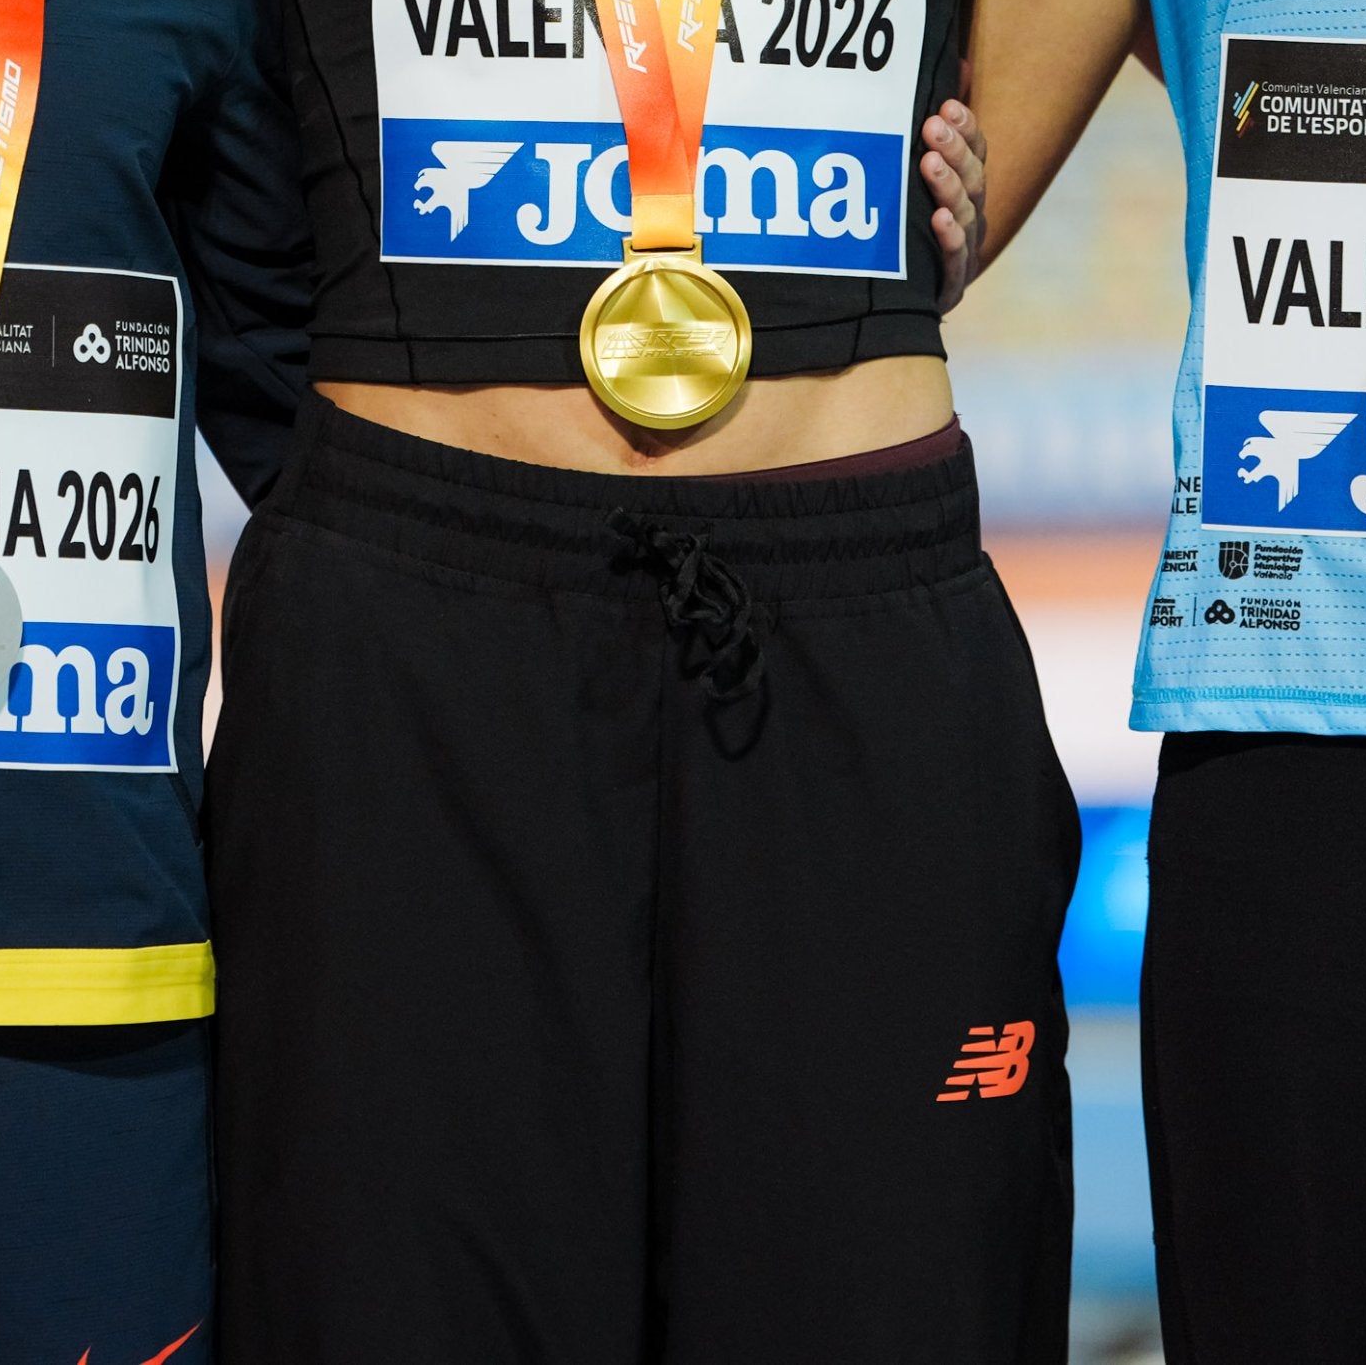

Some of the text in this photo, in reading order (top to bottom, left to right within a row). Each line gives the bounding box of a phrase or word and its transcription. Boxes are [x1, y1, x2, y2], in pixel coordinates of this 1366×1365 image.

[1261, 81, 1314, 94] Comunitat
[1267, 115, 1291, 133] DE
[115, 321, 170, 335] FUNDACIÓN
[115, 335, 170, 356] TRINIDAD
[115, 354, 170, 373] ALFONSO
[57, 469, 161, 563] 2026
[1254, 544, 1303, 555] Fundación
[1253, 553, 1302, 563] Deportiva
[1253, 562, 1300, 572] Municipal
[1253, 571, 1293, 580] València
[1241, 598, 1301, 608] FUNDACIÓN
[1240, 606, 1301, 620] TRINIDAD
[1239, 618, 1301, 631] ALFONSO
